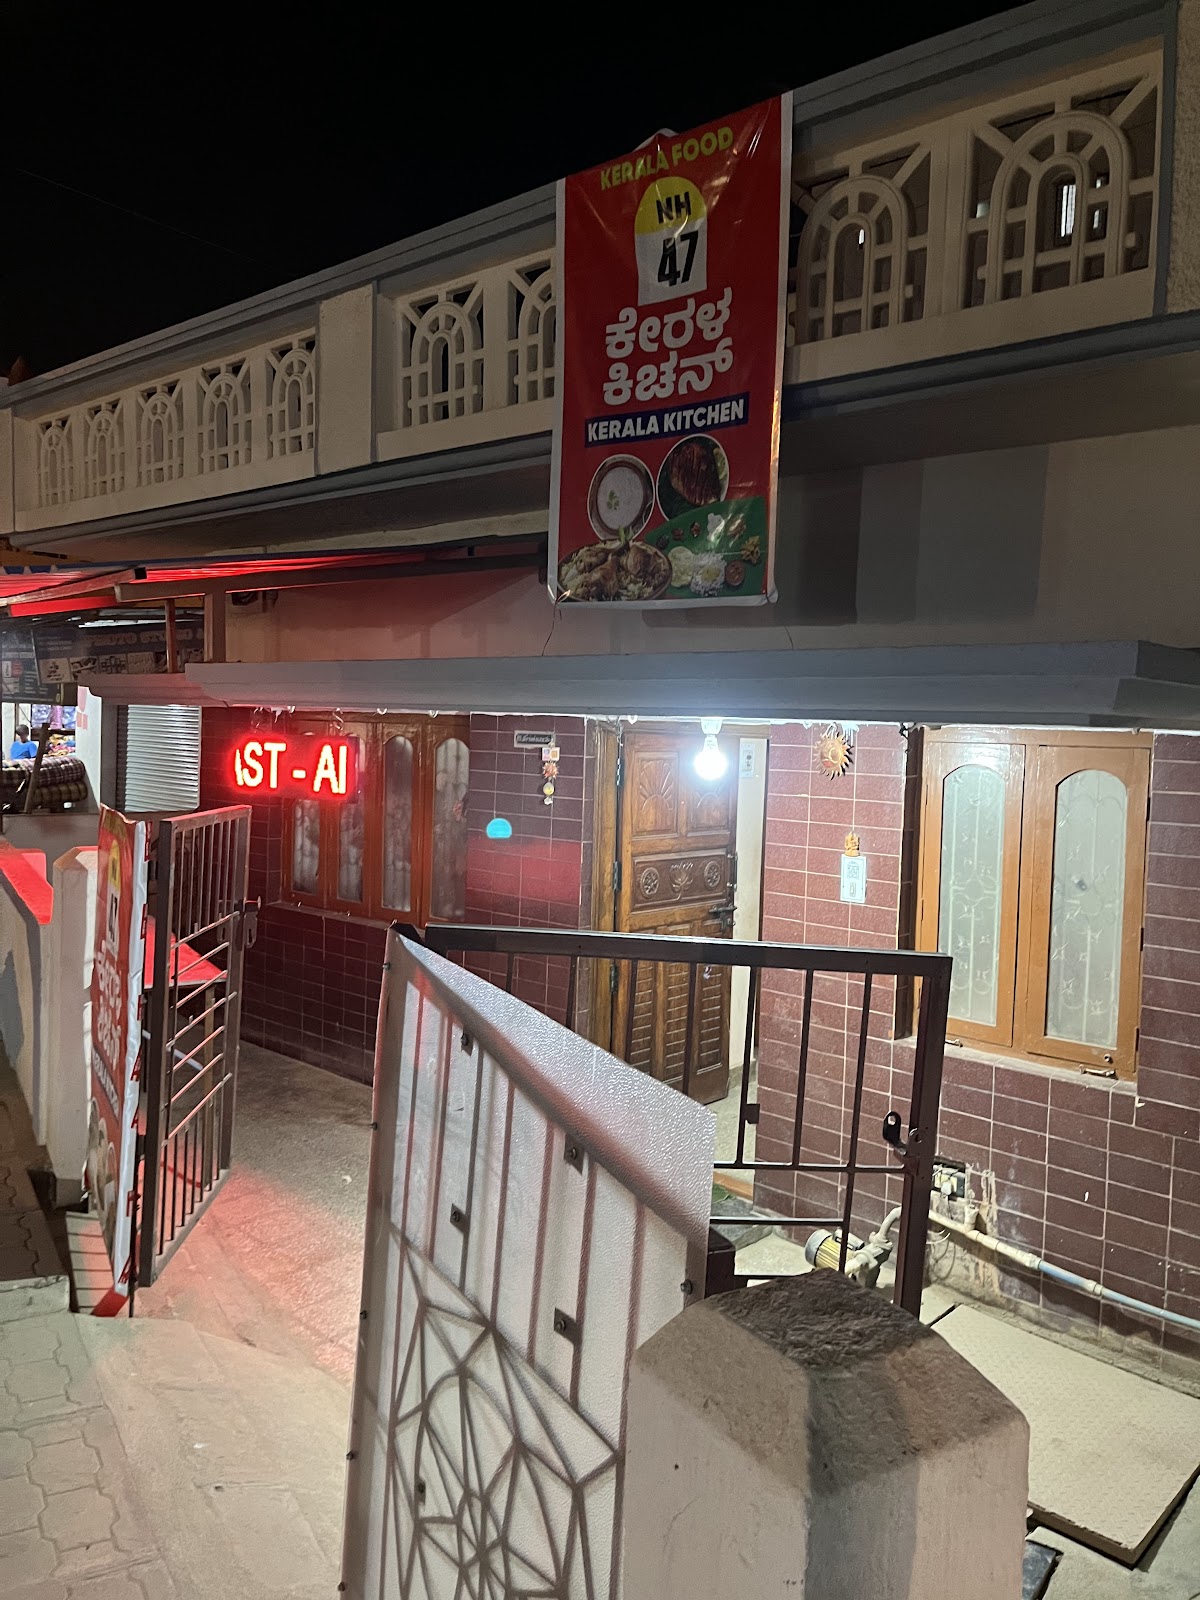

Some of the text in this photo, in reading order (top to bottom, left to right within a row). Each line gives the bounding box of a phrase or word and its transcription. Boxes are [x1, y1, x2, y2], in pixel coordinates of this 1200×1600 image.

[601, 126, 734, 191] KERALA FOOD
[655, 191, 692, 224] NH
[657, 230, 698, 287] 47
[605, 286, 732, 359] ಕೇರಳ
[602, 337, 734, 405] ಕಿಚನ್
[587, 399, 745, 442] KERALA KITCHEN
